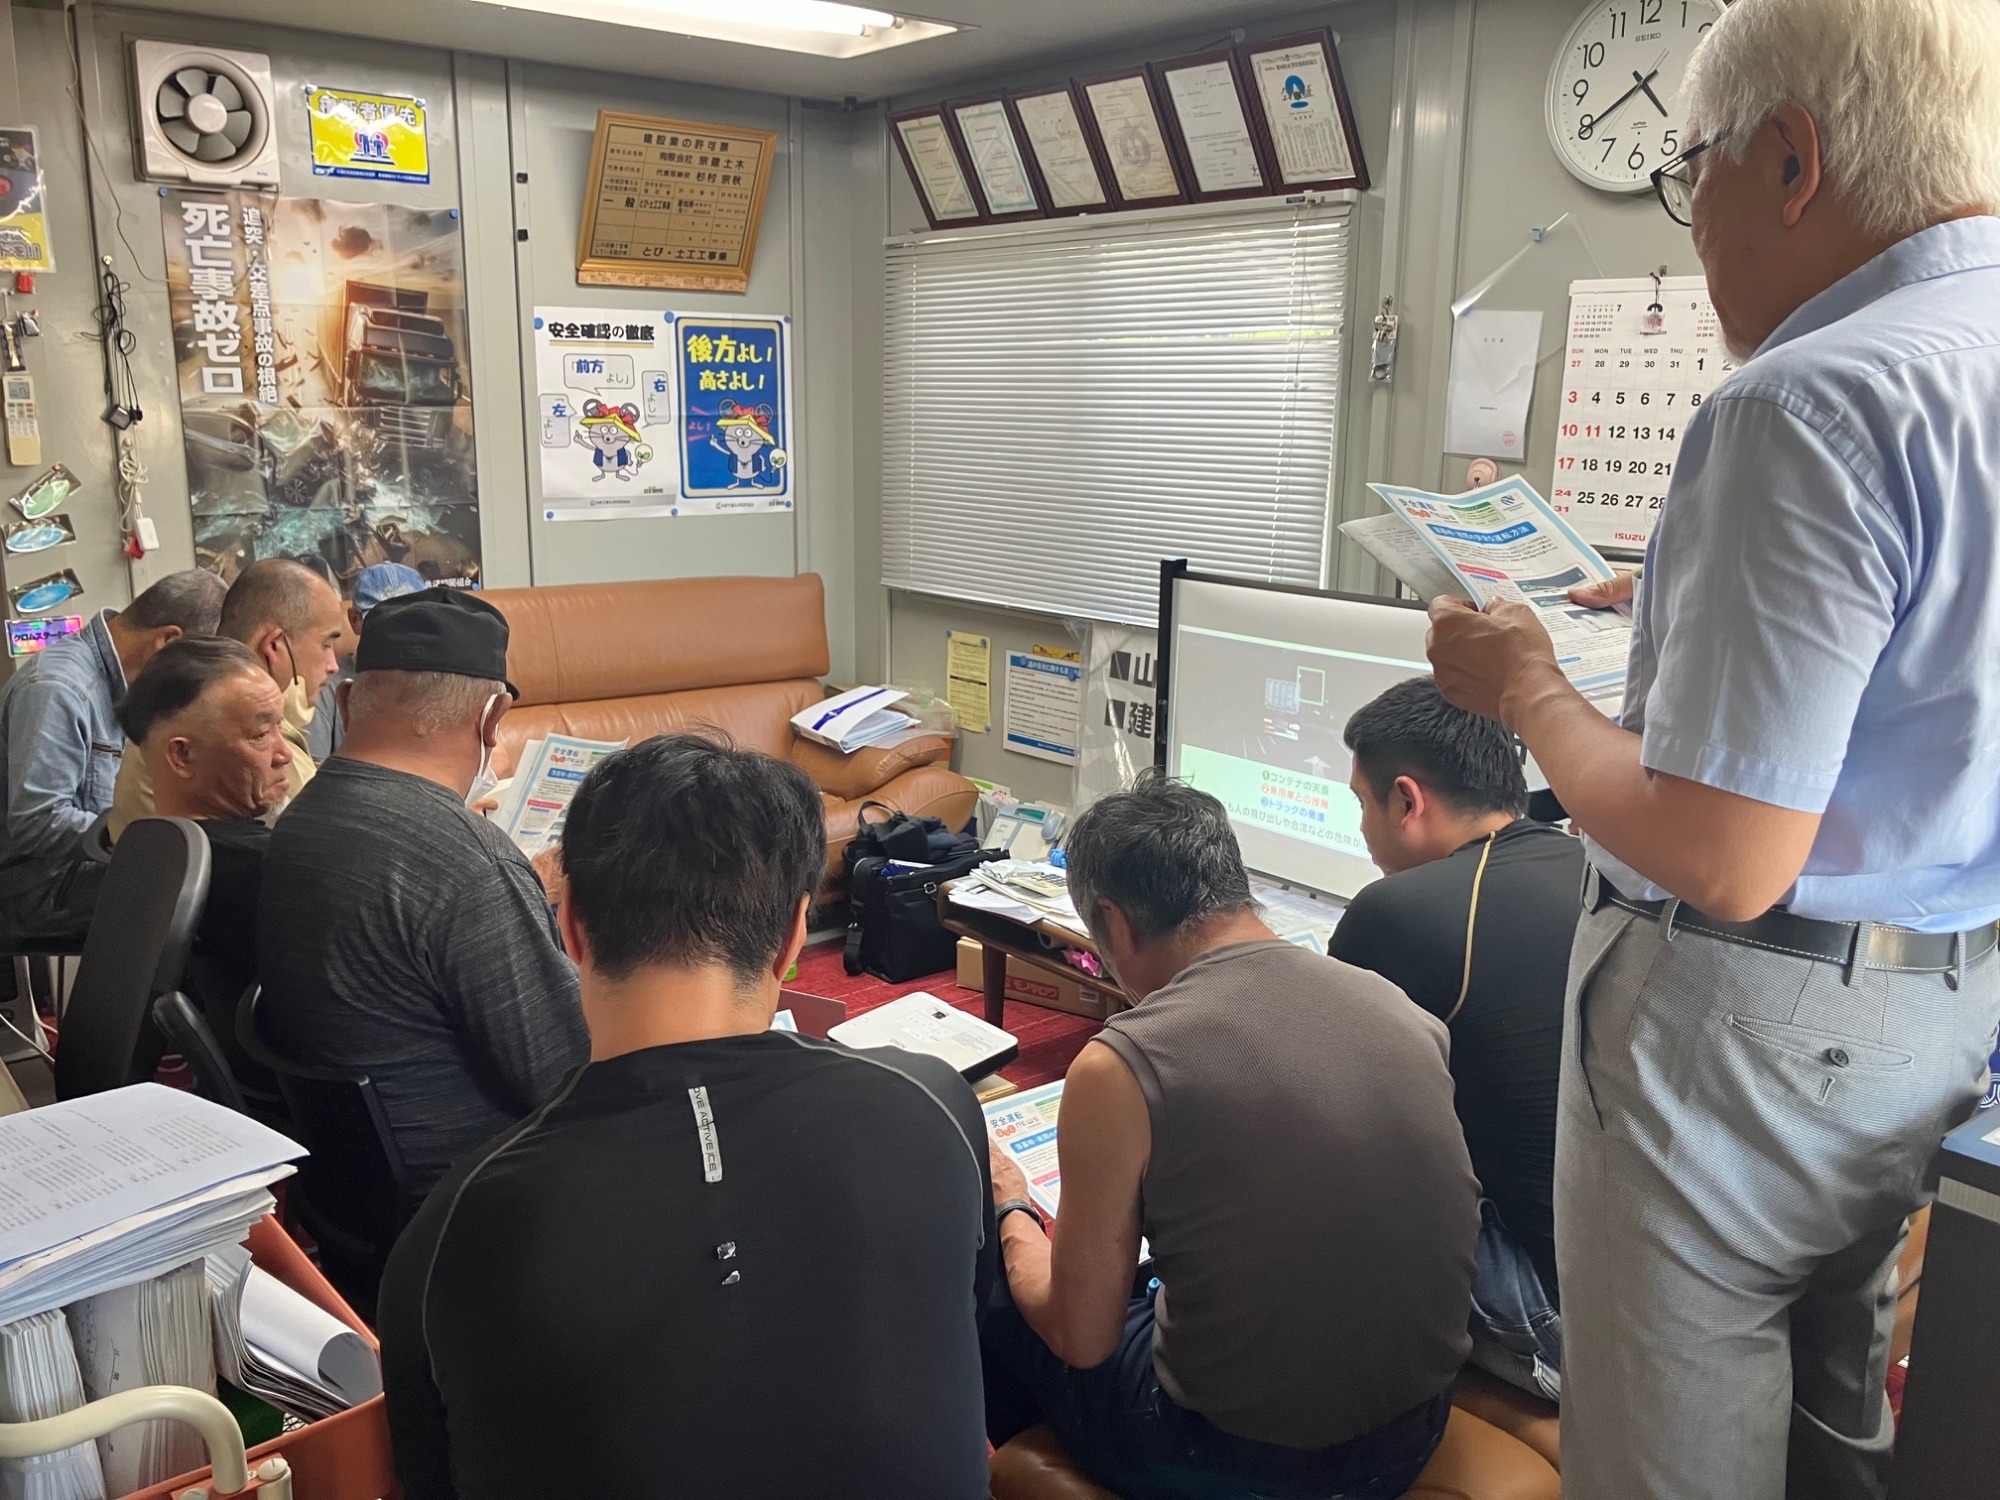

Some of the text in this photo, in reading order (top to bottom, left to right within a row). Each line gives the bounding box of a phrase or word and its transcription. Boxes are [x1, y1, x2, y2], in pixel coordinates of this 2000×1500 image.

[1640, 0, 1663, 25] 12
[1681, 1, 1688, 28] 1
[1610, 12, 1626, 39] 11
[1635, 32, 1662, 42] SEIKO
[1582, 42, 1605, 69] 10
[1573, 79, 1589, 106] 9
[1578, 113, 1594, 140] 8
[1601, 137, 1617, 163] 7
[1660, 129, 1678, 156] 5
[1628, 142, 1645, 170] 6
[181, 201, 244, 394] 死亡事故ゼロ
[548, 322, 655, 341] 安全確認の徹底
[687, 333, 773, 363] 後方よし！
[1571, 358, 1732, 371] 27 28 29 30 31 1 2
[699, 369, 765, 391] 高さよし！
[1568, 391, 1701, 406] 3 4 5 6 7 8
[1561, 424, 1676, 441] 10 11 12 13 14
[1558, 457, 1671, 476] 17 18 19 20 21
[1554, 489, 1572, 497] 24
[1577, 491, 1595, 504] 25
[1600, 493, 1619, 506] 26
[1625, 495, 1644, 508] 27
[1614, 532, 1646, 542] ISUZU
[1127, 700, 1154, 739] 建
[706, 1152, 717, 1172] ICE
